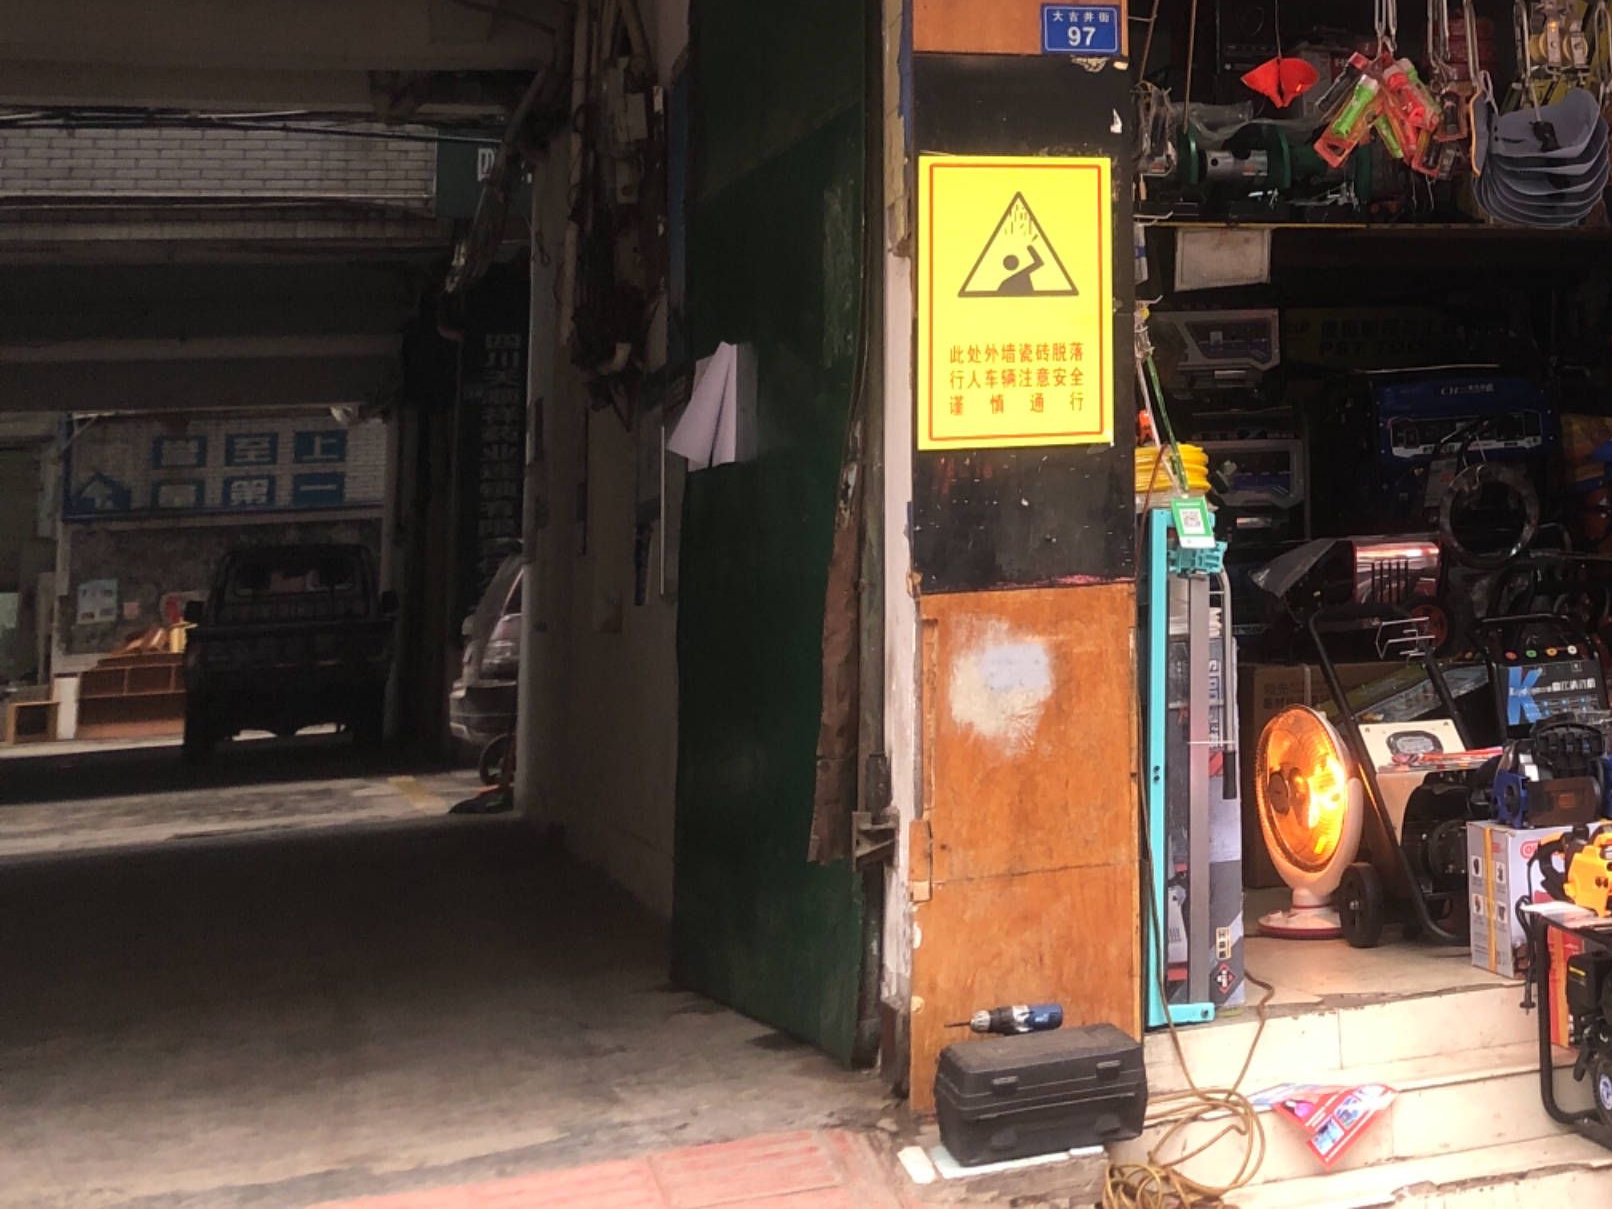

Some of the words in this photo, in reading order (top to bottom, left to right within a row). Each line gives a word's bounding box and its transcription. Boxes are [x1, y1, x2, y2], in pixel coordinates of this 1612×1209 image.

[1067, 25, 1097, 47] 97
[949, 341, 1085, 365] 此处外墙瓷砖脱落
[949, 366, 1085, 390] 行人车辆注意安全
